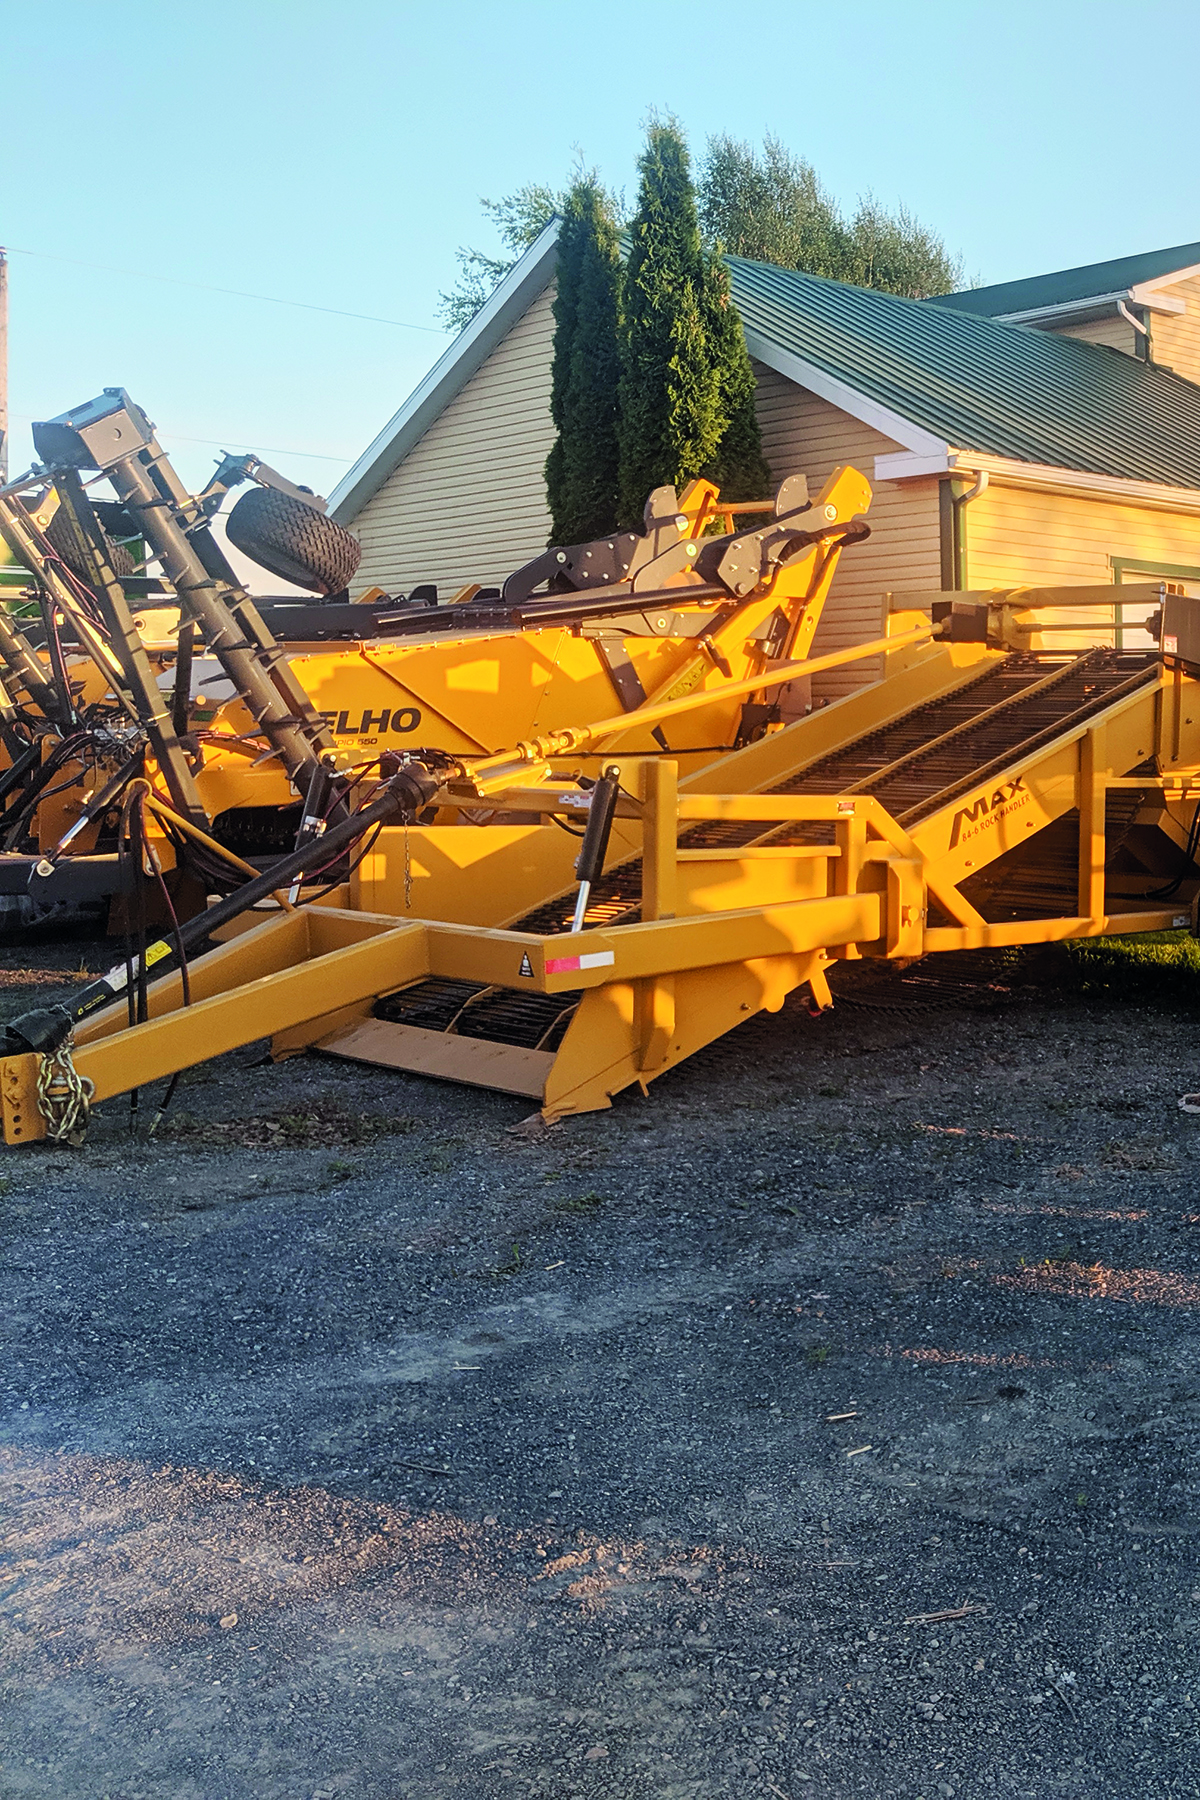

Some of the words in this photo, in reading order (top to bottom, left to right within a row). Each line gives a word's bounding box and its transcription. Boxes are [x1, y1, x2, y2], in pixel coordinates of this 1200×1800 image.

[357, 737, 378, 746] 550
[948, 775, 1026, 851] MAX
[962, 826, 979, 842] 84-6
[980, 813, 1000, 832] ROCK
[1000, 793, 1031, 818] HANDLER
